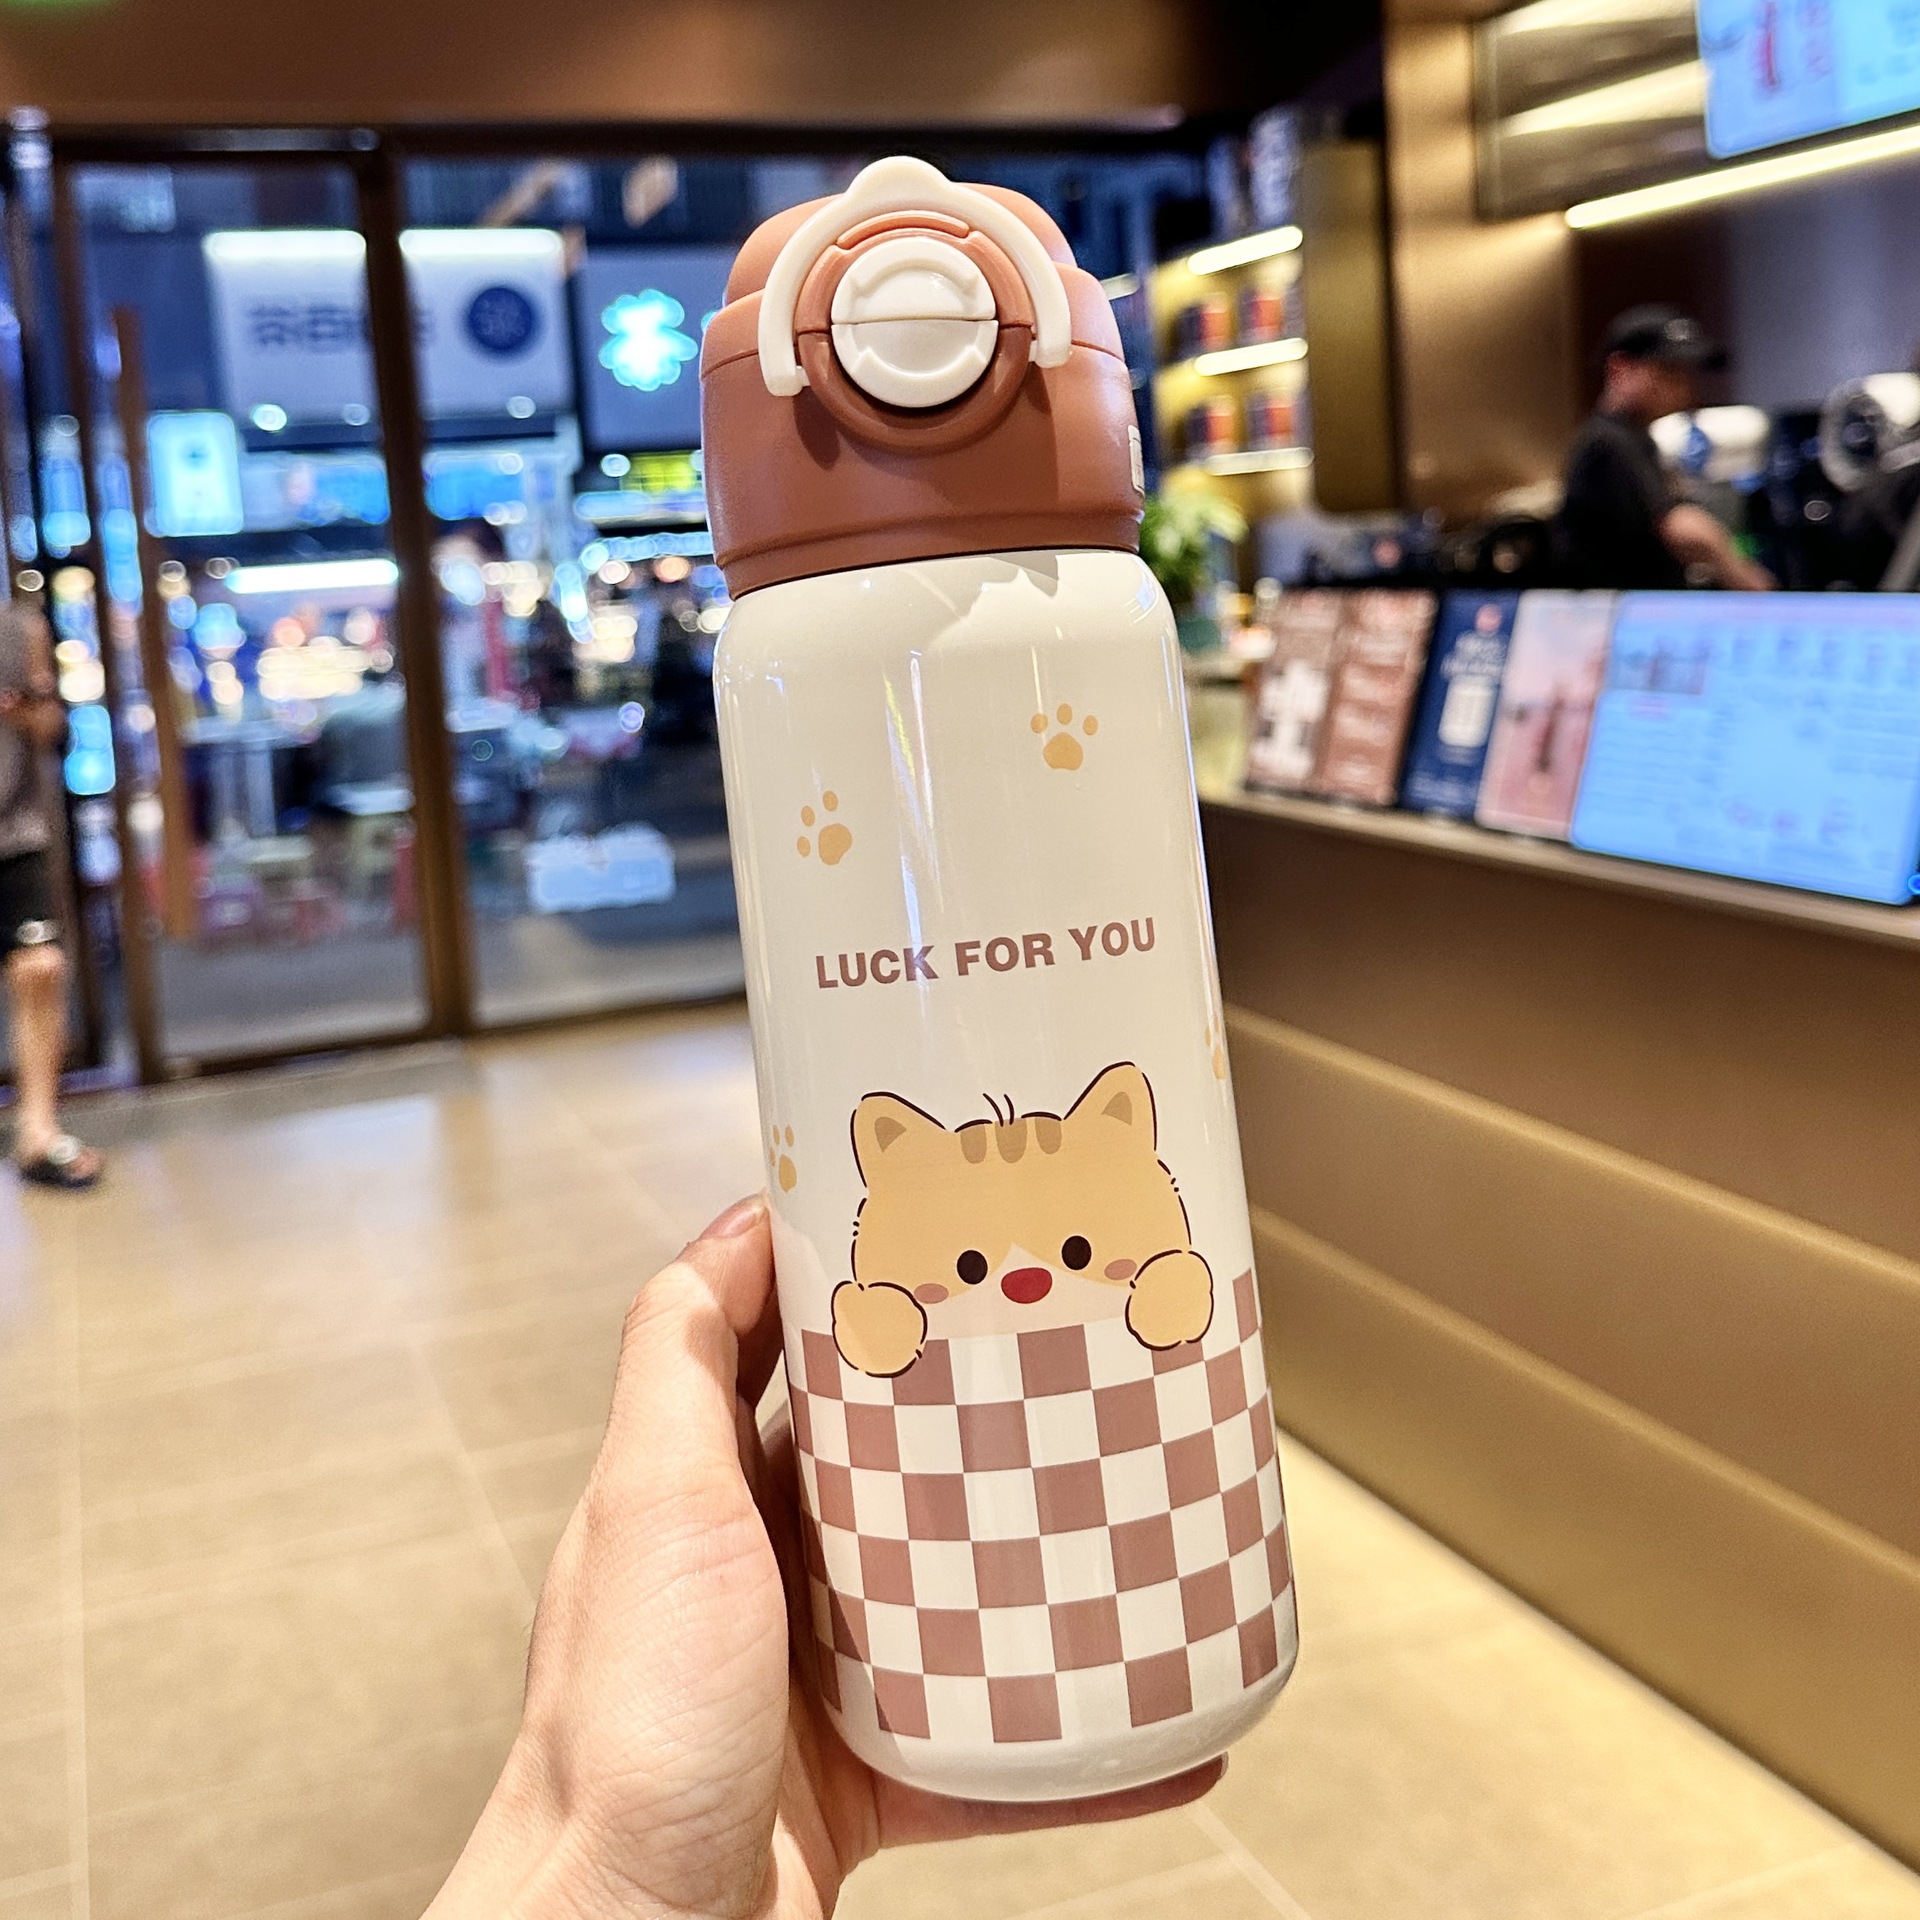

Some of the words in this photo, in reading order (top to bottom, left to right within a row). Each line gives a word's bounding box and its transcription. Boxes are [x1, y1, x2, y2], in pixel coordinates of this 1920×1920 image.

[815, 945, 939, 989] LUCK
[954, 932, 1056, 977] FOR
[1067, 917, 1156, 962] YOU
